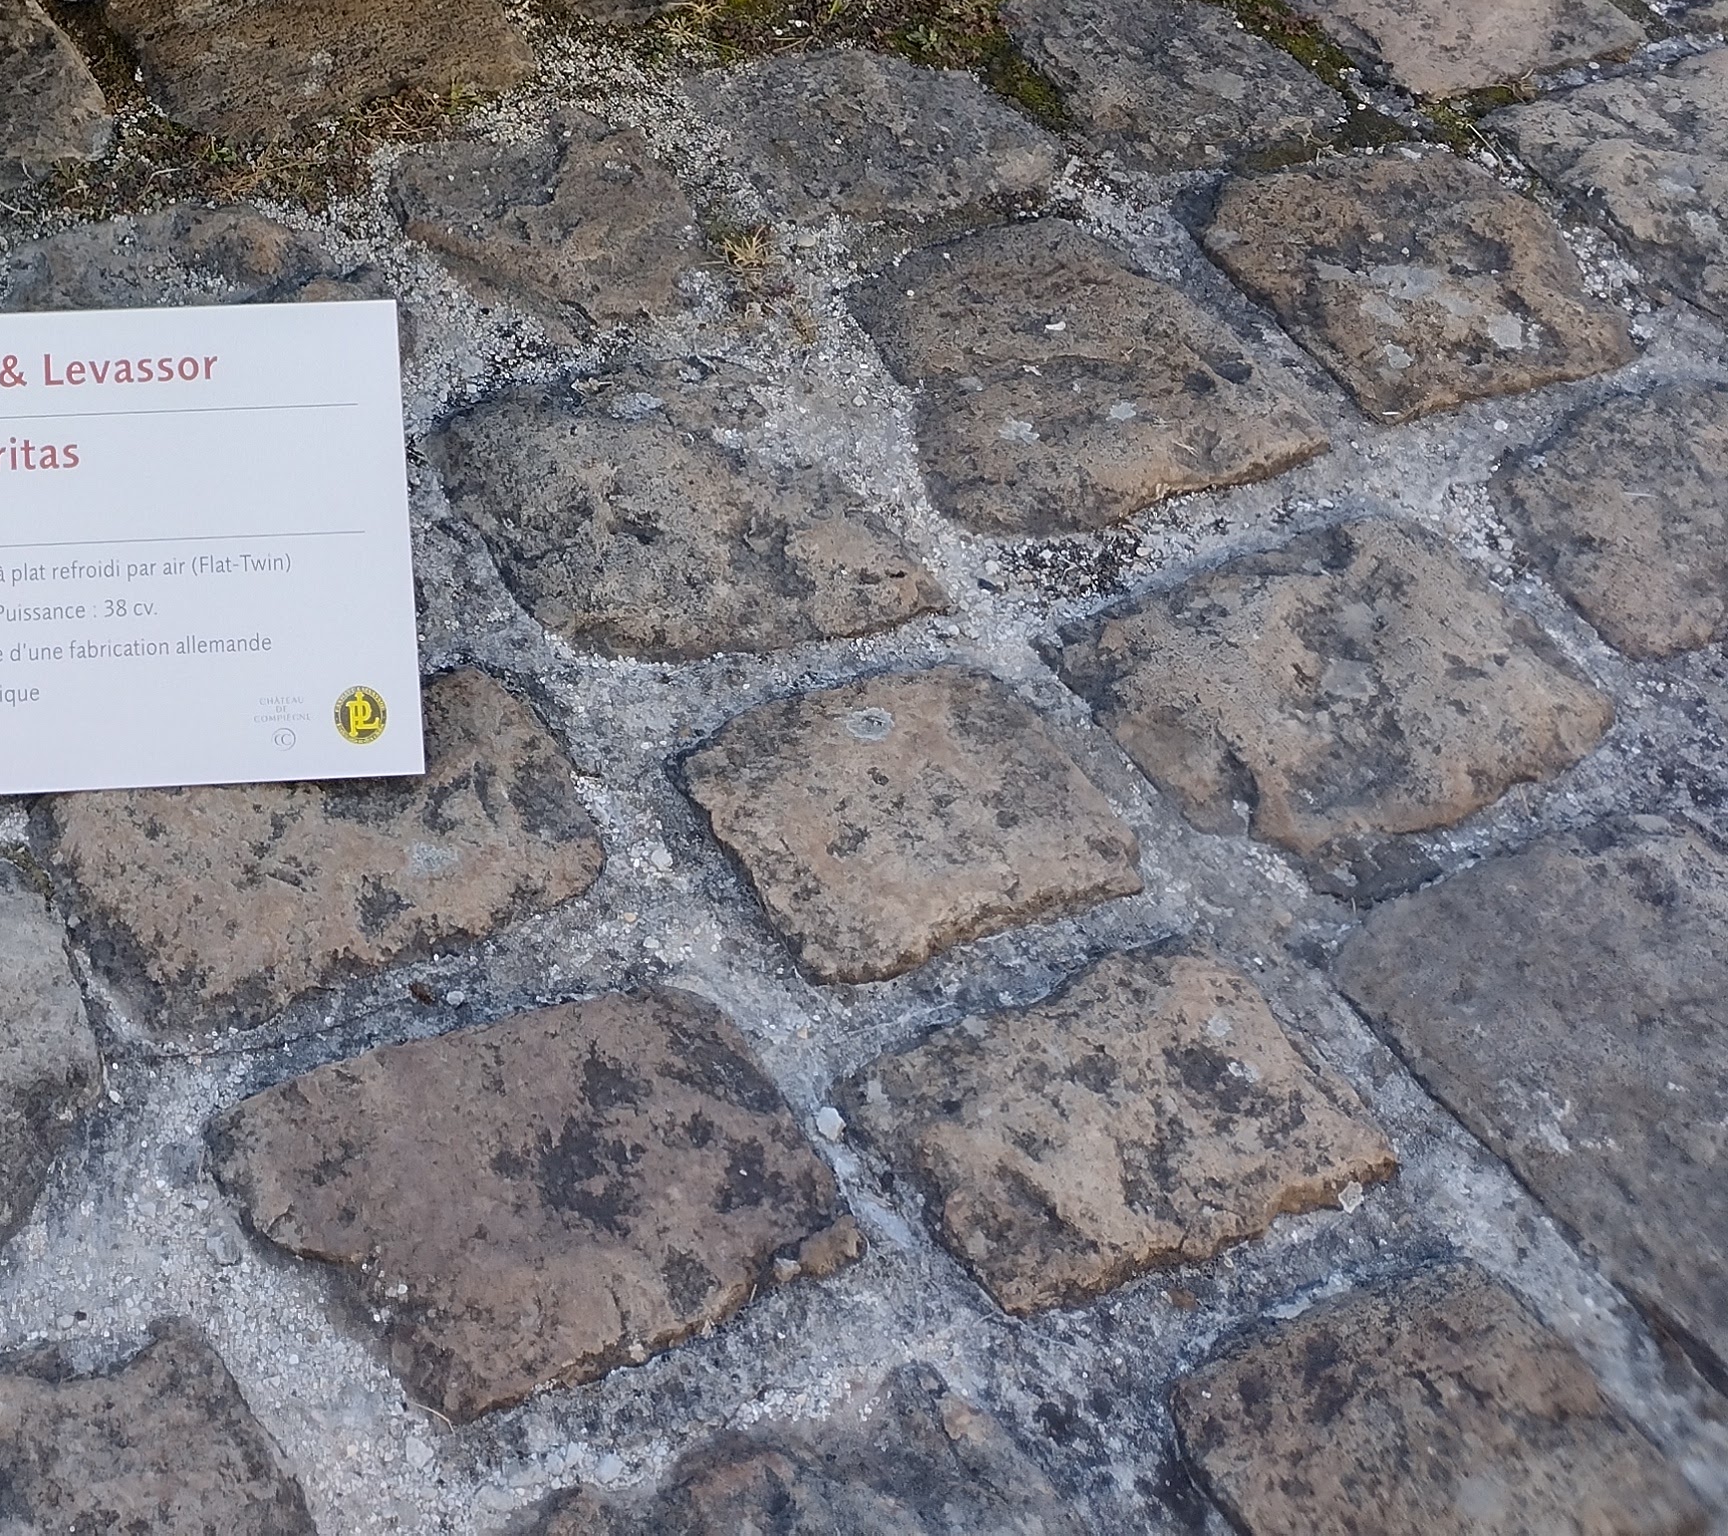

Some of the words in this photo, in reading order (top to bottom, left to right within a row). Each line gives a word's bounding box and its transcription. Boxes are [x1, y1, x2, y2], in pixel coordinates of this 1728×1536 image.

[43, 353, 218, 387] Levassor
[11, 561, 46, 588] plat
[52, 559, 120, 581] refroidi
[127, 562, 157, 583] par
[162, 557, 186, 576] air
[191, 552, 291, 577] (Flat-Twin)
[103, 598, 128, 618] 38
[133, 602, 158, 617] cv.
[9, 642, 64, 663] d'une
[69, 636, 170, 660] fabrication
[175, 631, 272, 655] allemande
